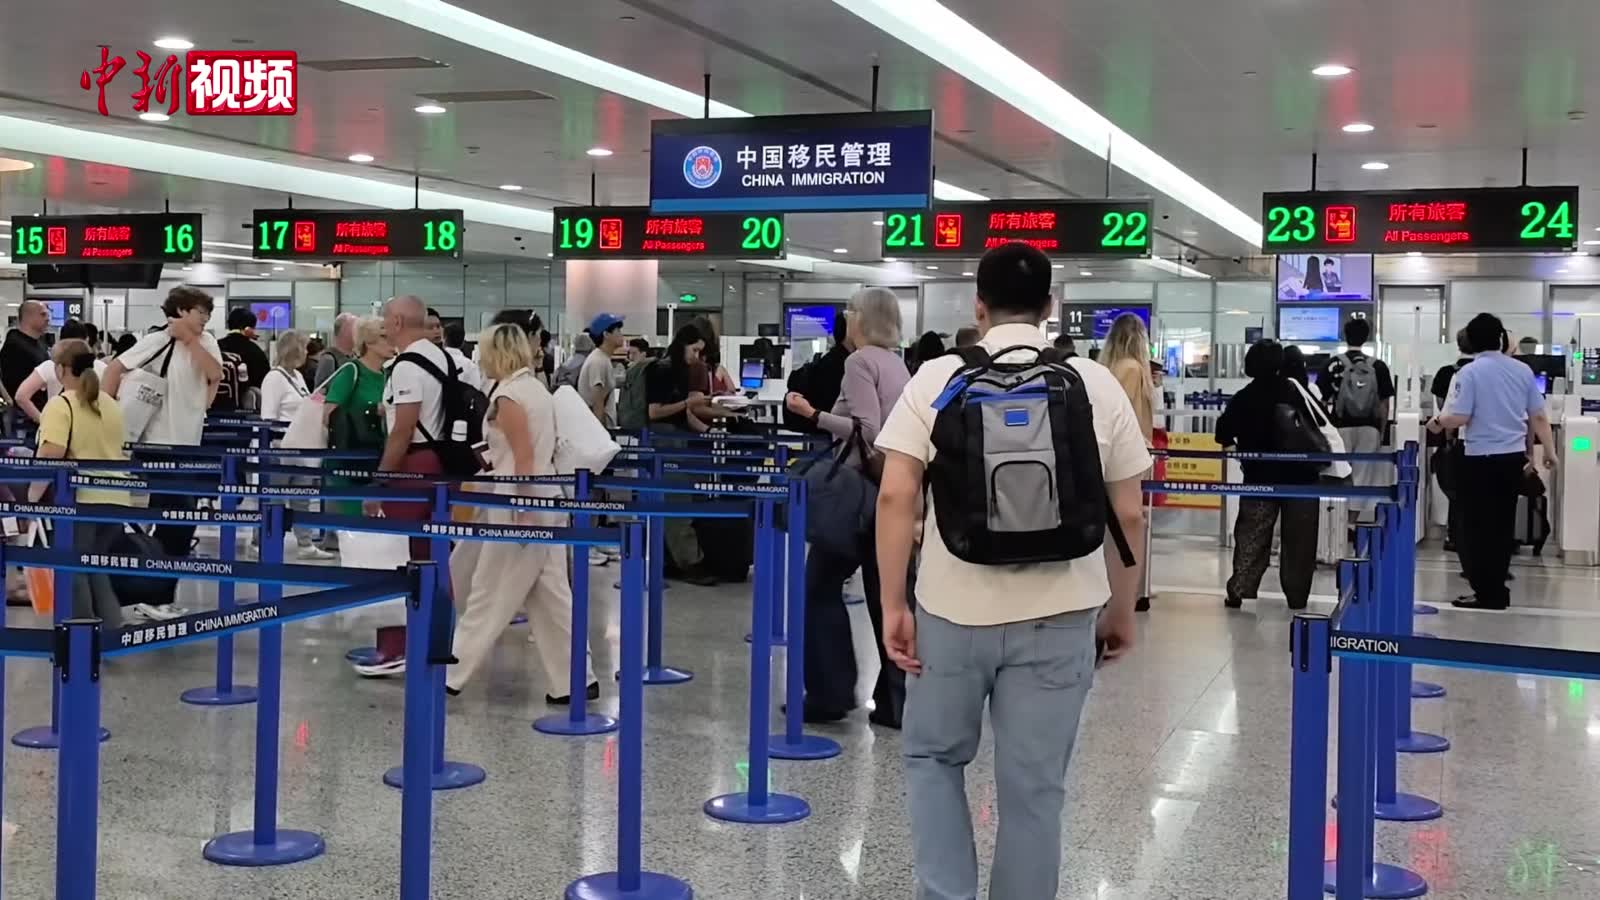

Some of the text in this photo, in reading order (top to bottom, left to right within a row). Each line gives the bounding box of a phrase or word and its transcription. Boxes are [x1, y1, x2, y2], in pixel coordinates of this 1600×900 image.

[737, 143, 892, 170] 中国移民管理
[741, 171, 885, 188] CHINA IMMIGRATION
[989, 212, 1056, 230] 所有旅客
[1389, 203, 1465, 222] 所有旅客
[1520, 202, 1573, 238] 24
[336, 222, 387, 238] 所有旅客
[646, 219, 703, 235] 所有旅客
[742, 217, 782, 249] 20
[887, 214, 924, 246] 21
[1102, 212, 1147, 246] 22
[1268, 206, 1315, 242] 23
[16, 227, 43, 254] 15
[84, 226, 131, 241] 所有旅客
[164, 224, 193, 252] 16
[259, 221, 289, 250] 17
[424, 221, 456, 250] 18
[560, 218, 593, 249] 19
[1385, 230, 1469, 244] All Passengers
[655, 240, 704, 251] Passengers
[985, 237, 1057, 249] All Pengers
[69, 304, 80, 315] 08
[1069, 310, 1082, 323] 11
[261, 487, 280, 495] CHINA
[14, 504, 34, 513] CHINA
[34, 504, 76, 515] IMMIGRATION
[560, 500, 580, 508] CHINA
[580, 501, 625, 510] IMMIGRATION
[214, 513, 236, 521] CHINA
[422, 523, 553, 540] 中国移民管理 CHINA IMMIGRATION
[80, 554, 232, 574] 中国移民管理 CHINA IMMIGRATION
[121, 606, 278, 647] 中国移民管理 CHINA IMMIGRATION
